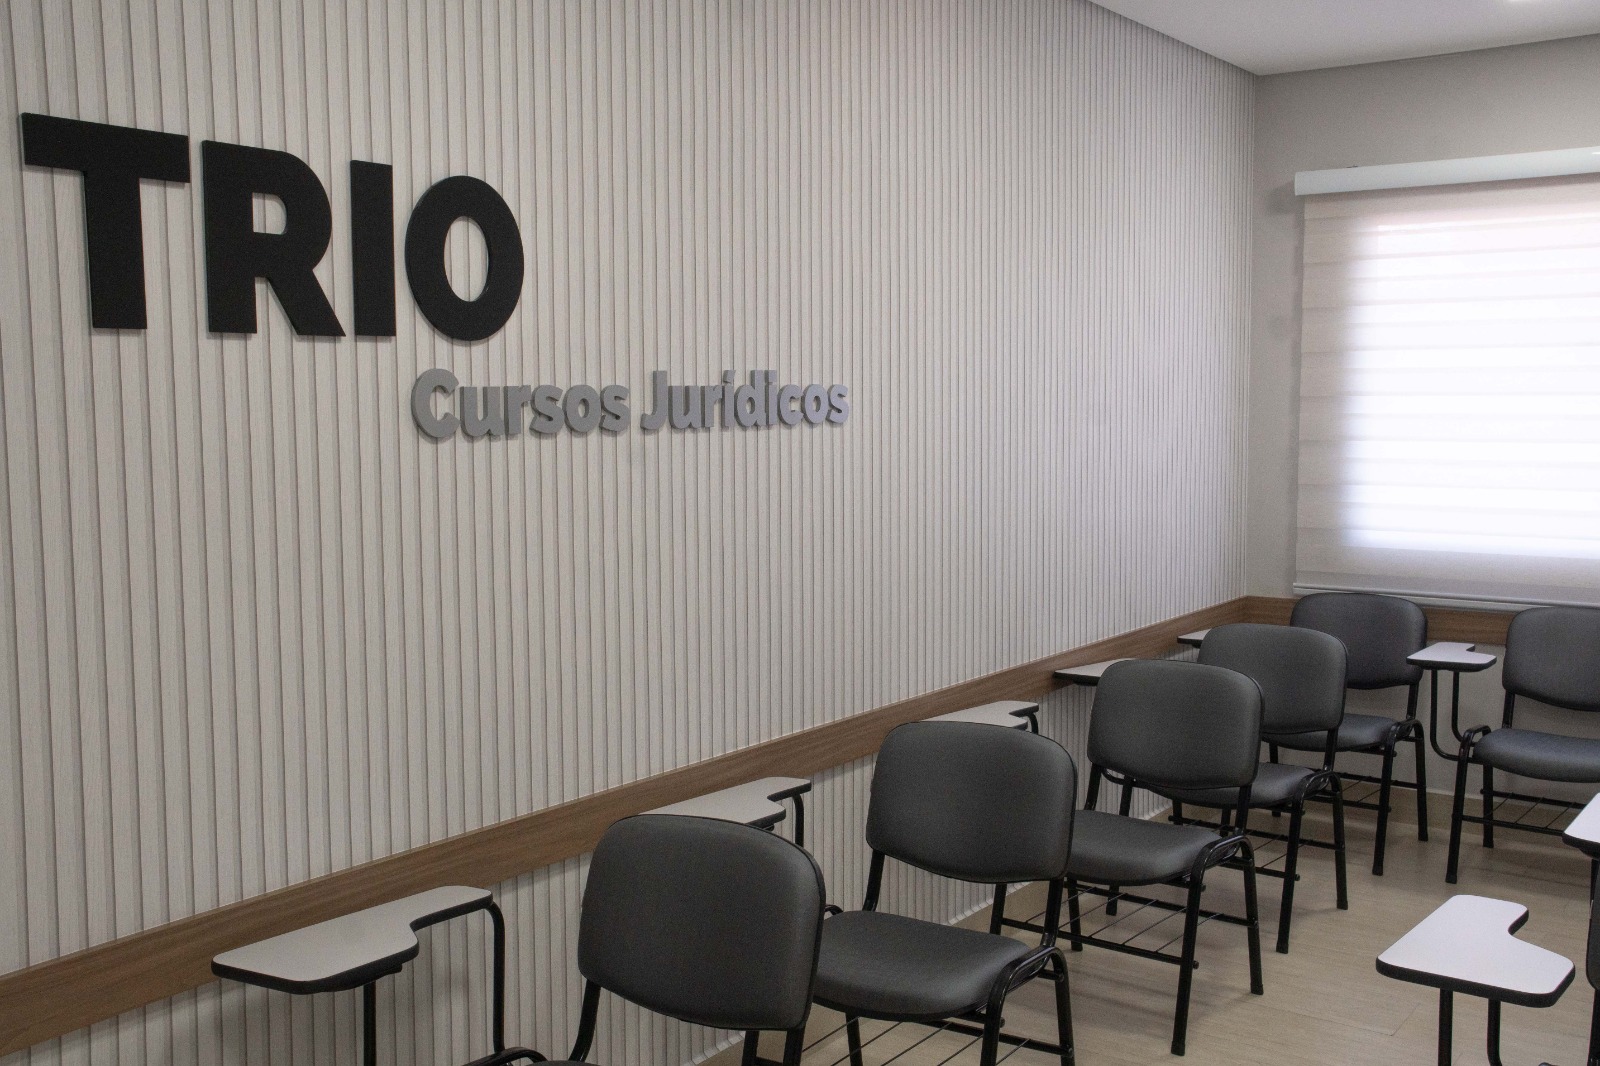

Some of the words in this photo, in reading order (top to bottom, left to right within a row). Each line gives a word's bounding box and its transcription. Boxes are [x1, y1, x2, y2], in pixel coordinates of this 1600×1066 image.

[21, 112, 524, 341] TRIO
[411, 368, 630, 438] Cursos
[640, 369, 850, 430] Jurídicos
